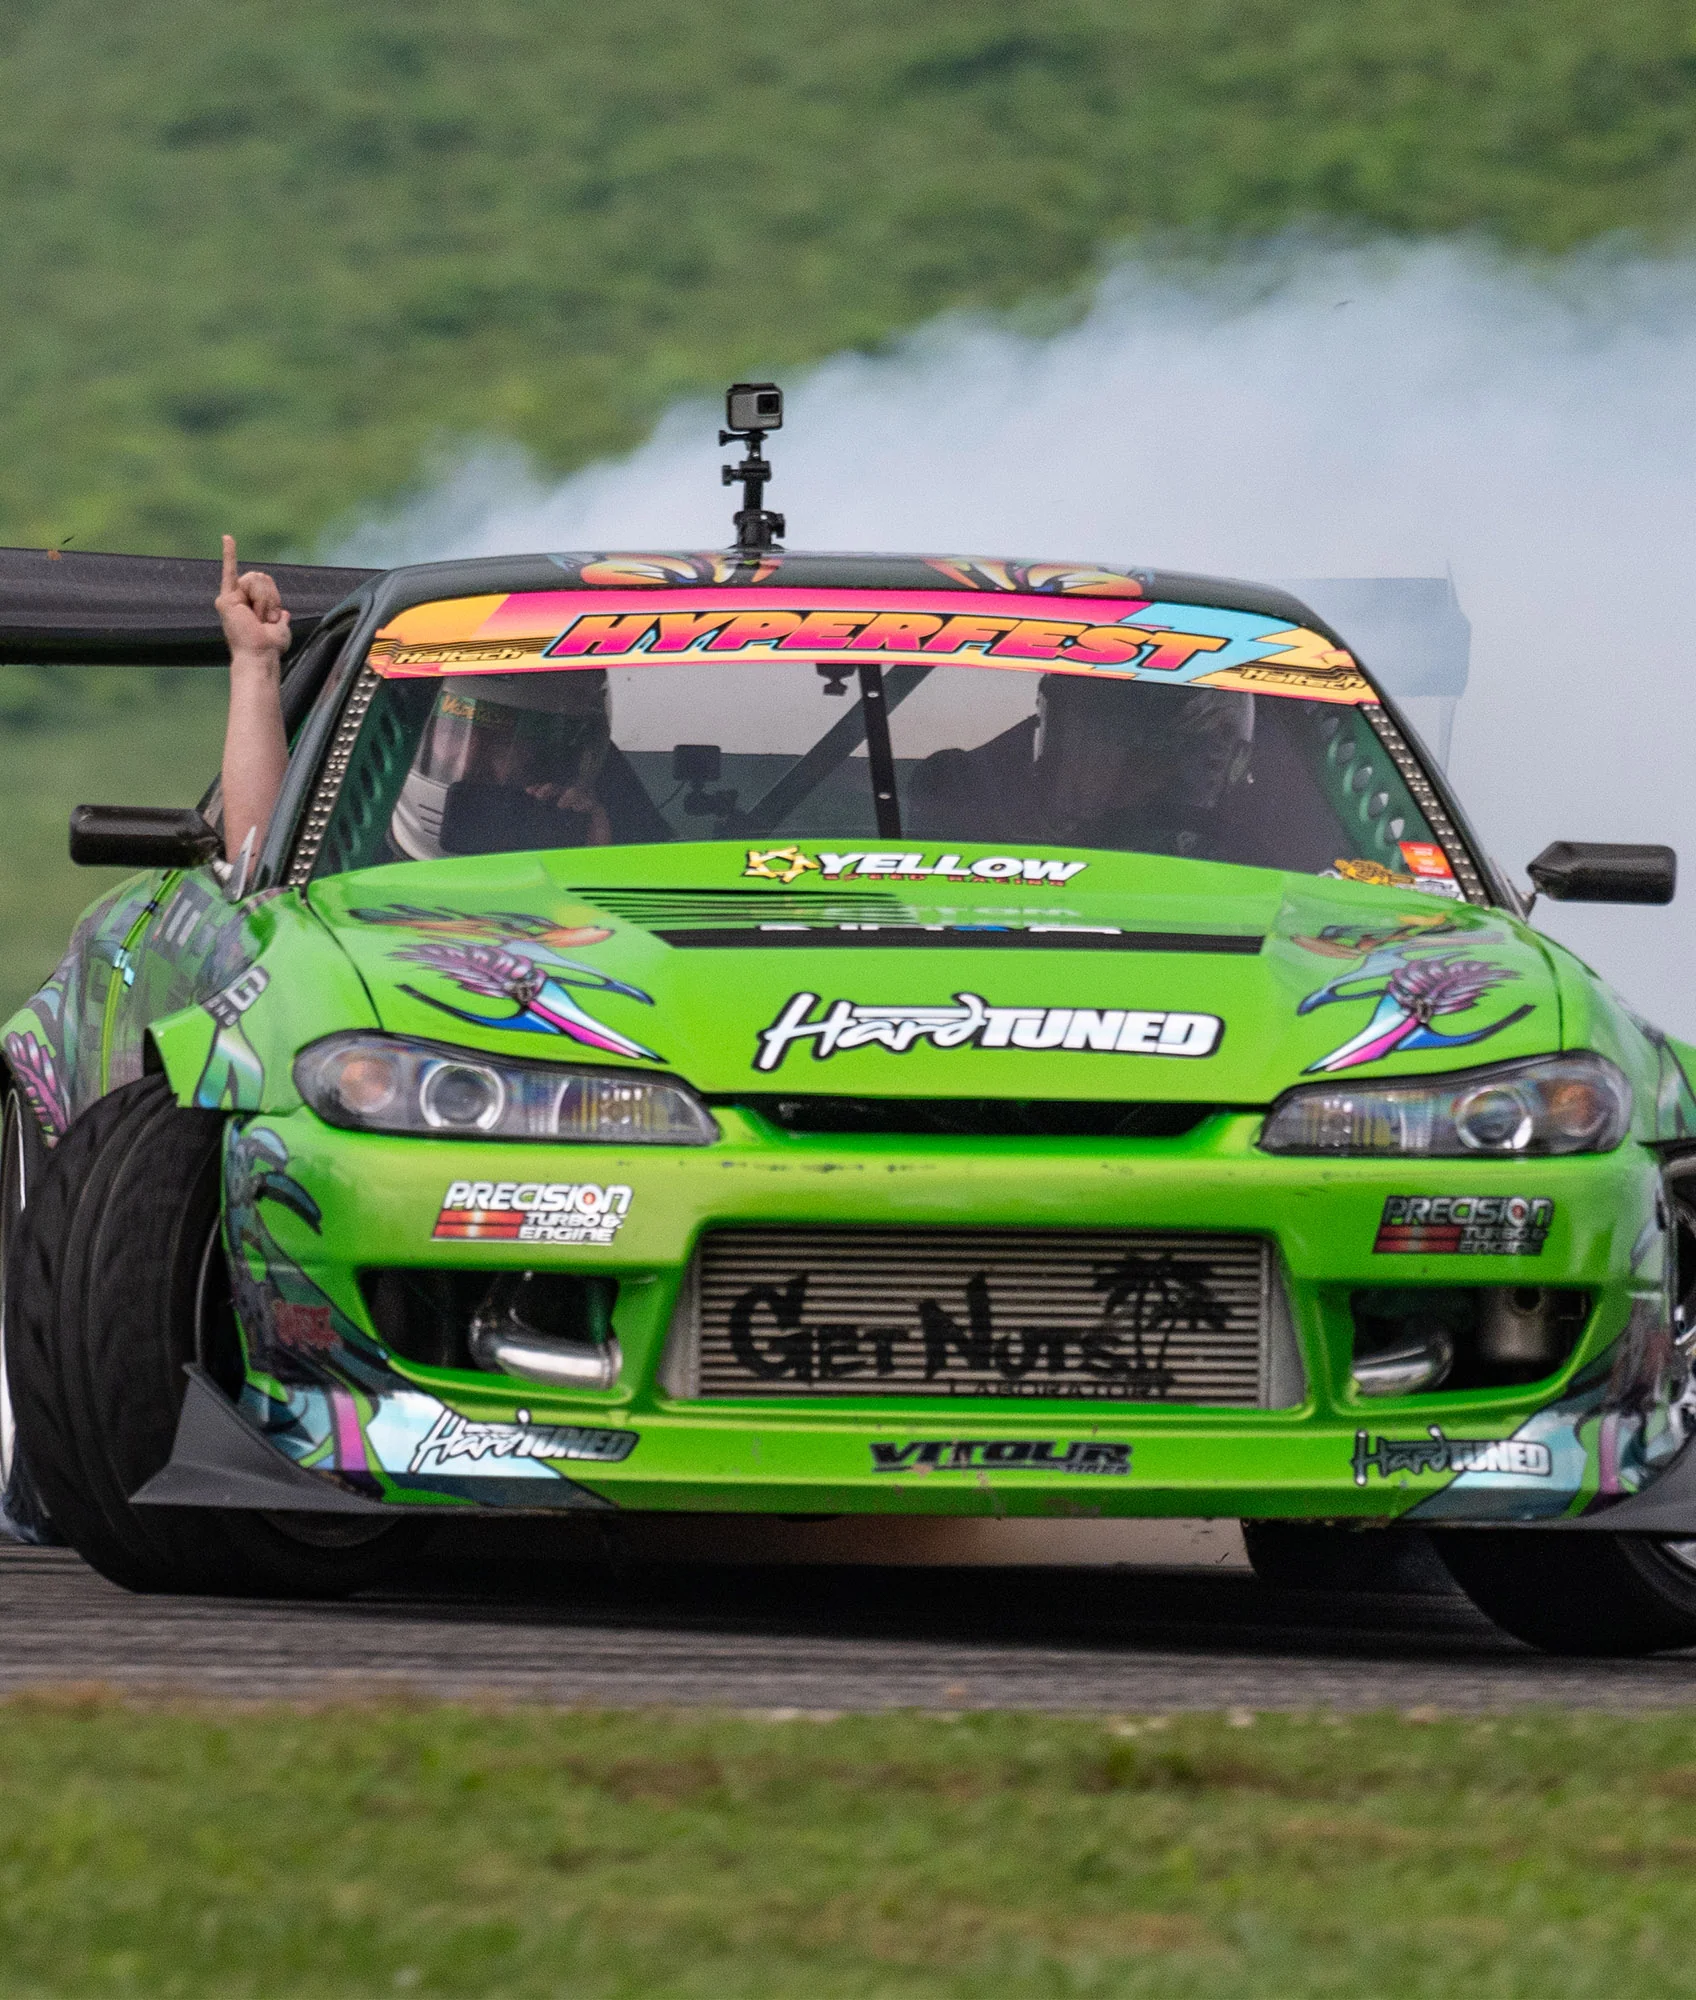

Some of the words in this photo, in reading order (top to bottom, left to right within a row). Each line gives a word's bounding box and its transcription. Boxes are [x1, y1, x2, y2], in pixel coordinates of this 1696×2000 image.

[547, 610, 1229, 671] HYPERFEST
[393, 649, 522, 664] Haltech
[1240, 668, 1368, 691] Haltech
[817, 853, 1088, 883] YELLOW
[443, 1181, 634, 1214] PRECISION
[526, 1213, 596, 1227] TURBO
[869, 1441, 1133, 1465] VITOUR
